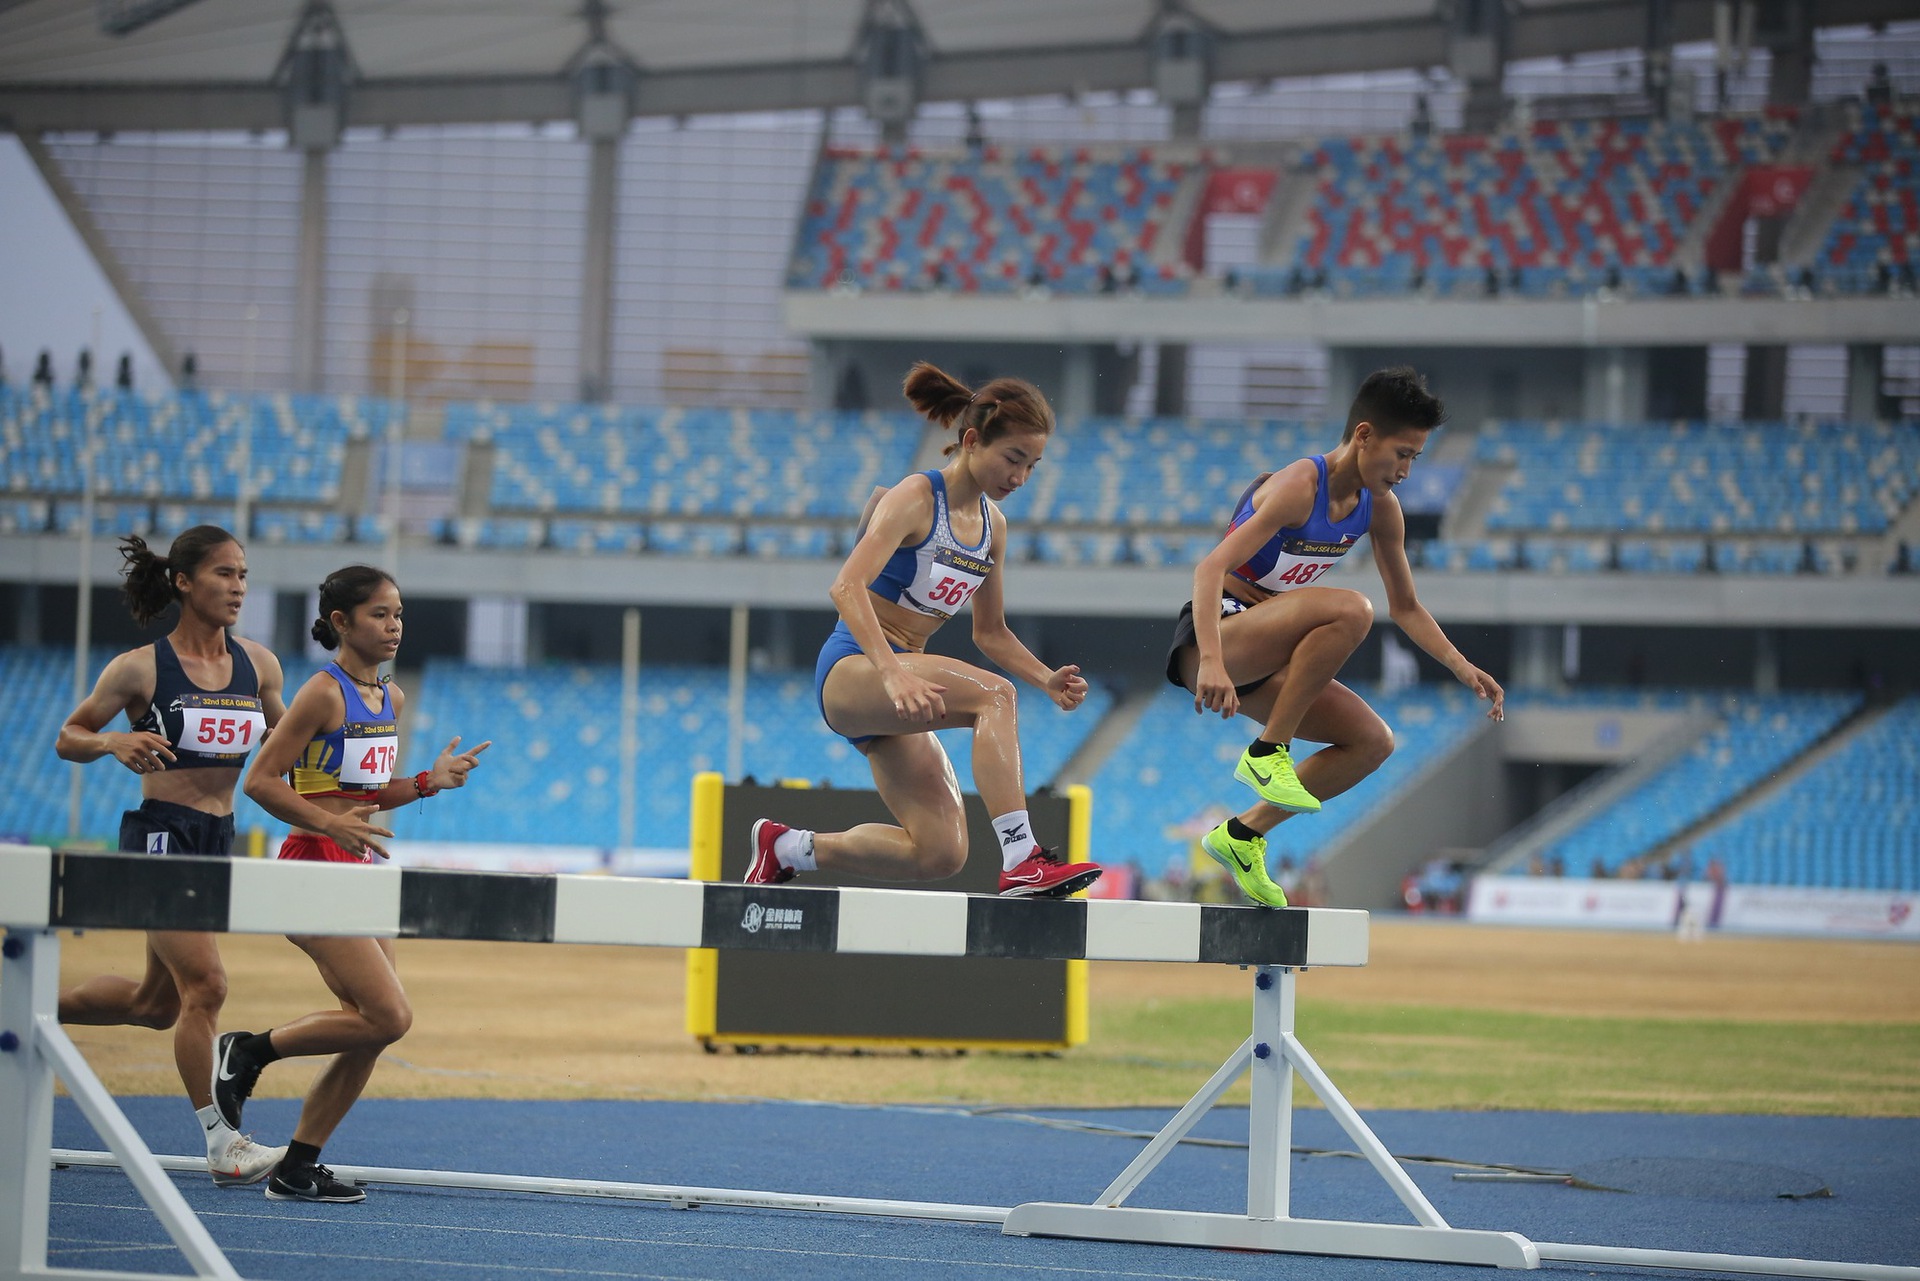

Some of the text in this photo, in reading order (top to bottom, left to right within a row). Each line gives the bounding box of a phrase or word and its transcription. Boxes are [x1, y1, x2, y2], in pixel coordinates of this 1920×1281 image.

[953, 556, 968, 567] 32nd
[968, 561, 980, 571] SEA
[1279, 563, 1334, 585] 487
[928, 576, 979, 607] 561
[202, 698, 256, 709] 32nd SEA GAMES
[197, 717, 252, 745] 551
[363, 726, 377, 734] 32nd
[377, 725, 385, 733] SEA
[360, 745, 395, 775] 476
[150, 833, 164, 854] 4
